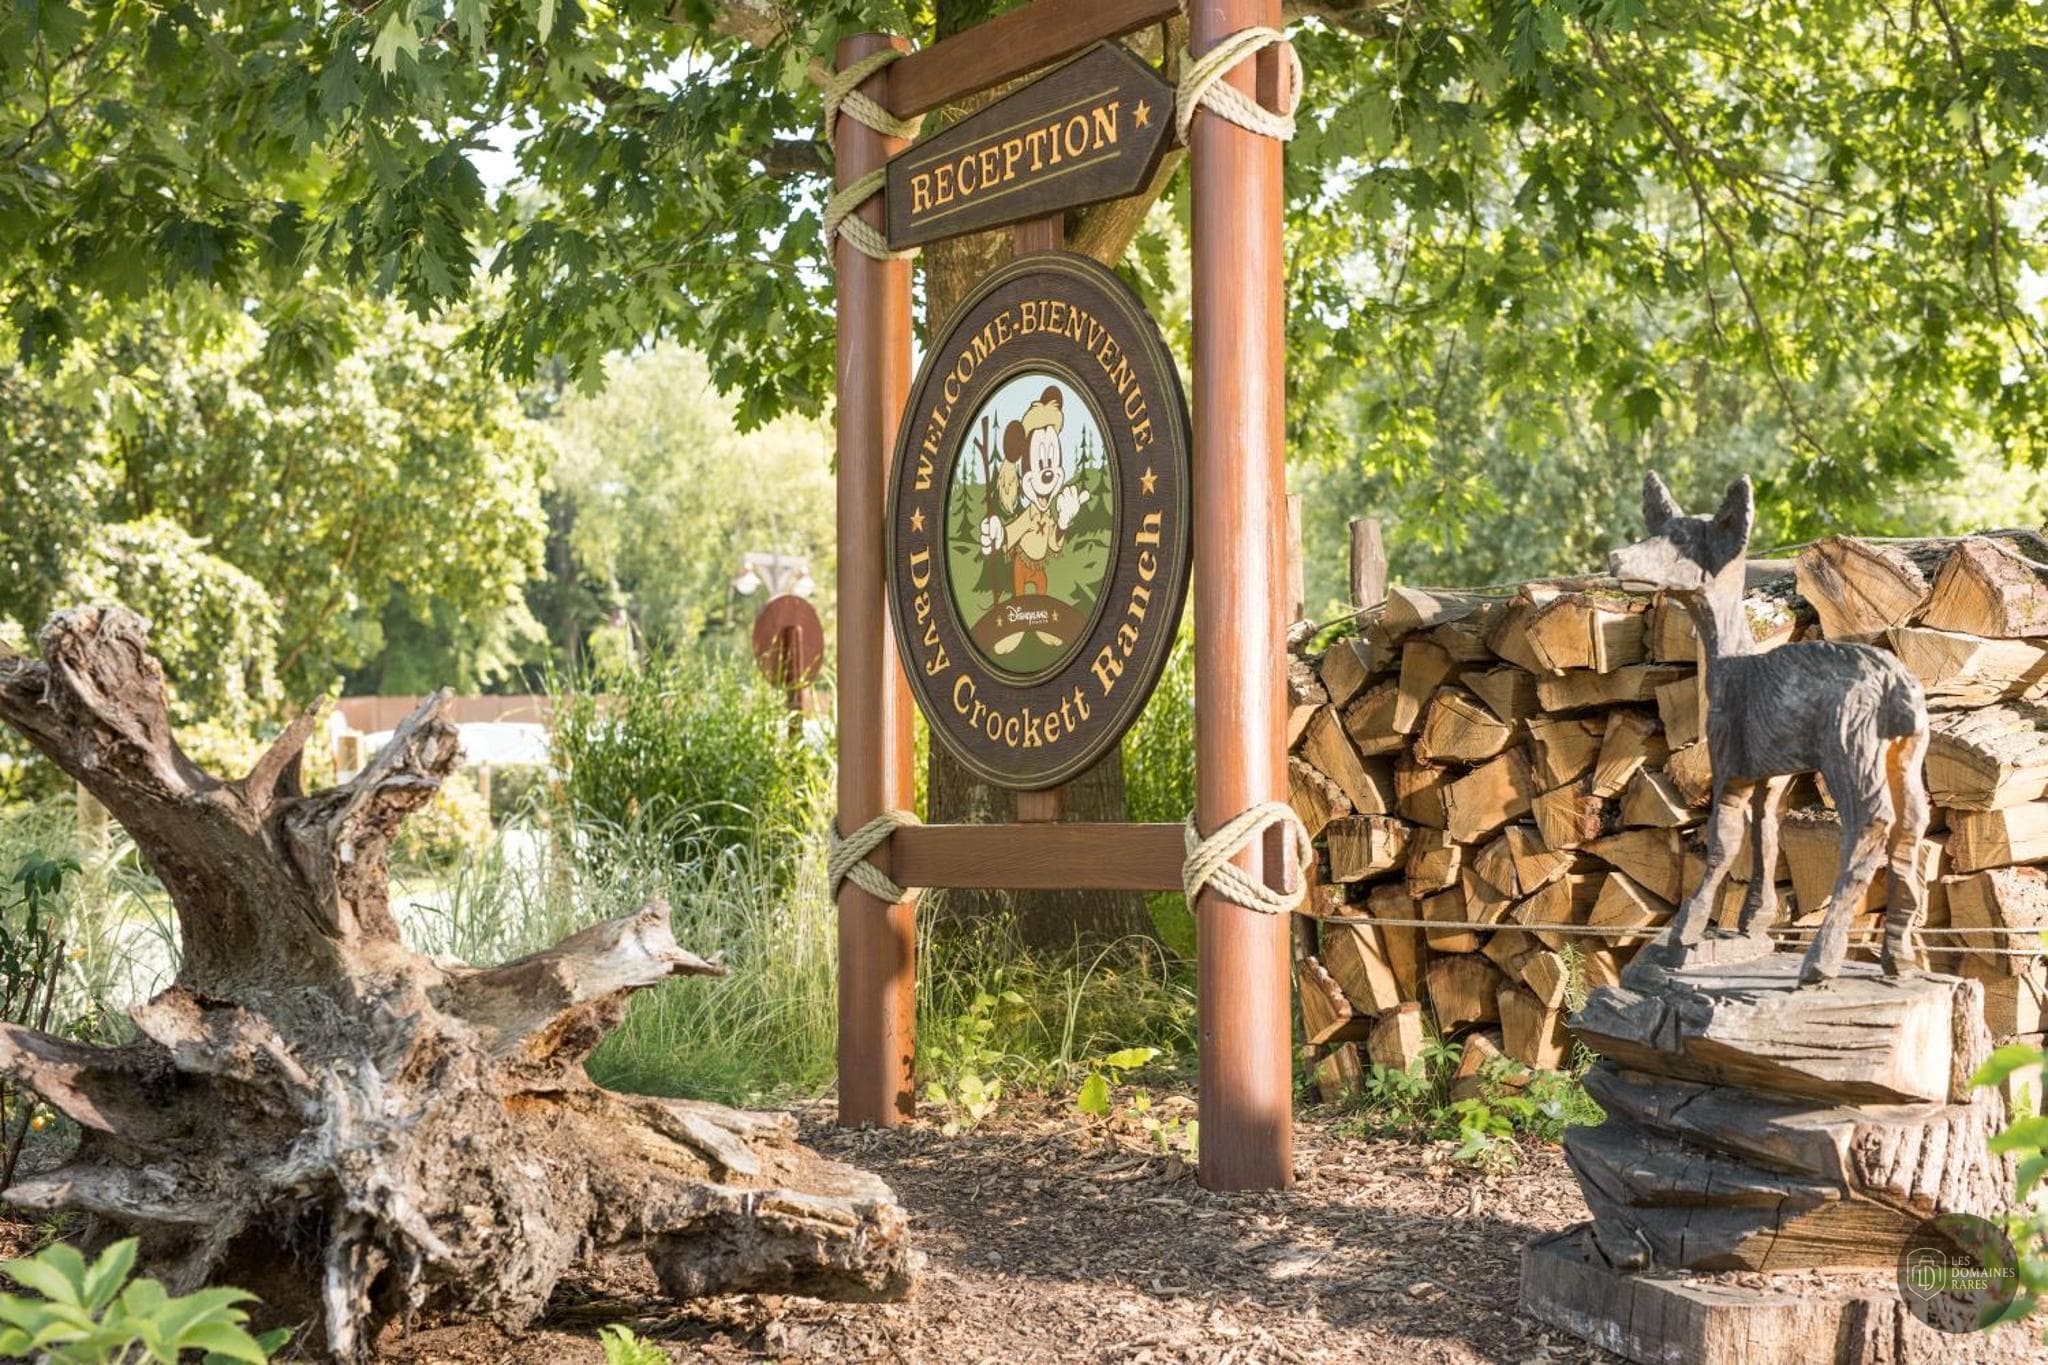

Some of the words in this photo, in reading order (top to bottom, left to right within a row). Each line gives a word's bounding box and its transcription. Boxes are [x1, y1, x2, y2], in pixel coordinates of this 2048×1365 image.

[911, 102, 1119, 214] RECEPTION
[910, 546, 950, 677] Davy
[953, 674, 1091, 748] Crockett
[1091, 510, 1163, 697] Ranch
